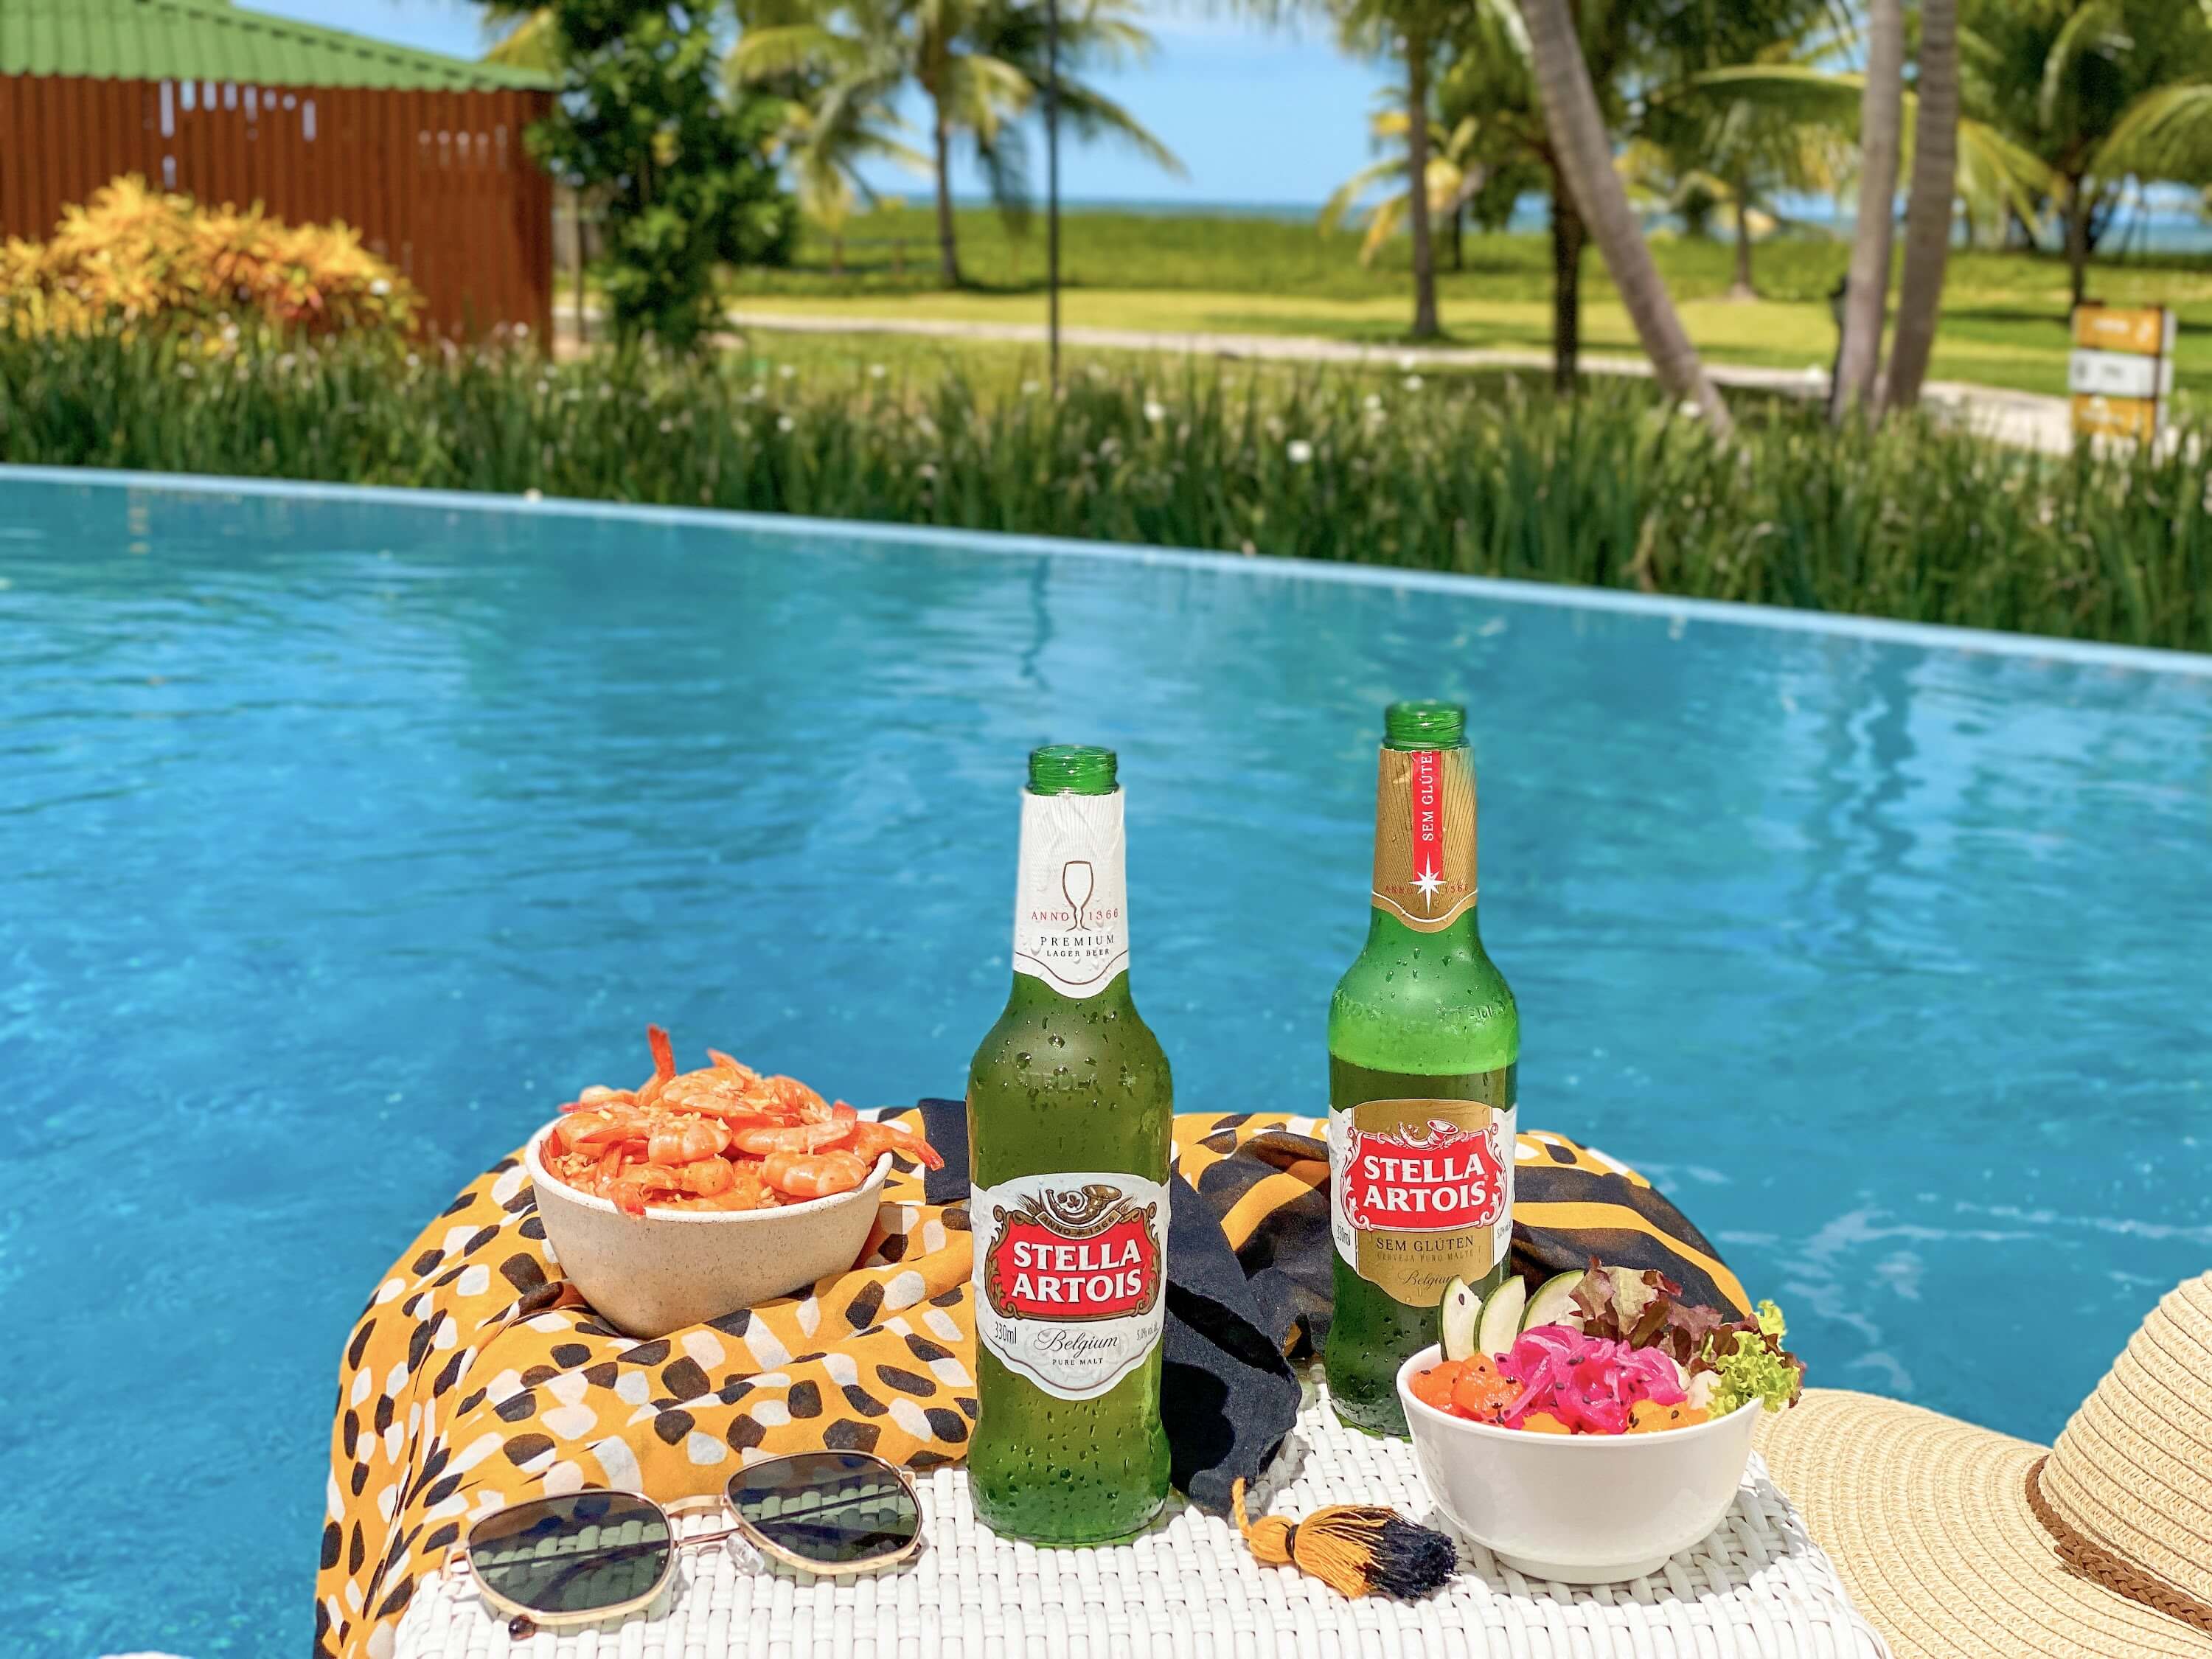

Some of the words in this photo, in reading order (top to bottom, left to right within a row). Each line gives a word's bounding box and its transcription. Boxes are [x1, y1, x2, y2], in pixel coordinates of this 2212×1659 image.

[1422, 811, 1434, 841] SEM
[1032, 911, 1069, 921] ANNO
[1089, 908, 1119, 920] 1366
[1040, 933, 1114, 947] PREMIUM
[1086, 948, 1110, 956] BEER
[1363, 1152, 1486, 1183] STELLA
[1363, 1180, 1486, 1211] ARTOIS
[1040, 1215, 1071, 1236] ANNO
[1090, 1215, 1115, 1234] 1366
[1376, 1237, 1406, 1251] SEM
[1413, 1235, 1473, 1252] GLÚTEN
[1013, 1239, 1142, 1271] STELLA
[1420, 1253, 1443, 1263] PURO
[1447, 1250, 1473, 1261] MALTE
[1011, 1268, 1142, 1303] ARTOIS
[995, 1321, 1017, 1344] 330ml
[1033, 1328, 1119, 1359] Belgium
[1079, 1357, 1103, 1366] MALT
